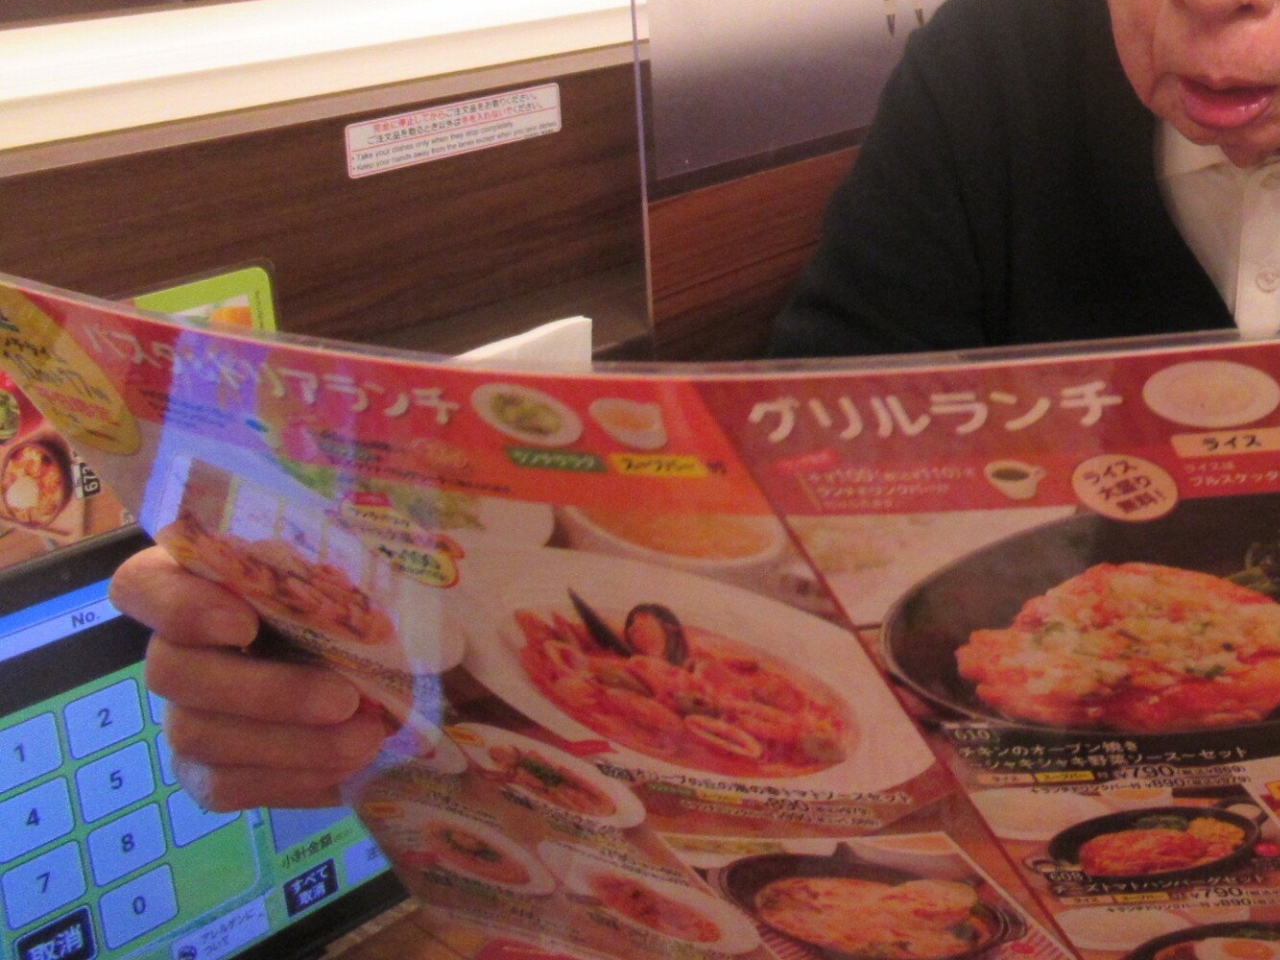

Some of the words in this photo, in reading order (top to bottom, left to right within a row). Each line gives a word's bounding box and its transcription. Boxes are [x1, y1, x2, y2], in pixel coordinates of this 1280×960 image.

[747, 380, 1123, 444] グリルランチ
[1201, 434, 1263, 452] ライス
[1084, 458, 1139, 486] ライス
[70, 611, 101, 630] No.
[97, 706, 114, 729] 2
[13, 744, 27, 764] 1
[109, 769, 124, 791] 5
[25, 808, 42, 828] 4
[120, 832, 136, 853] 8
[36, 872, 52, 893] 7
[132, 894, 147, 915] 0
